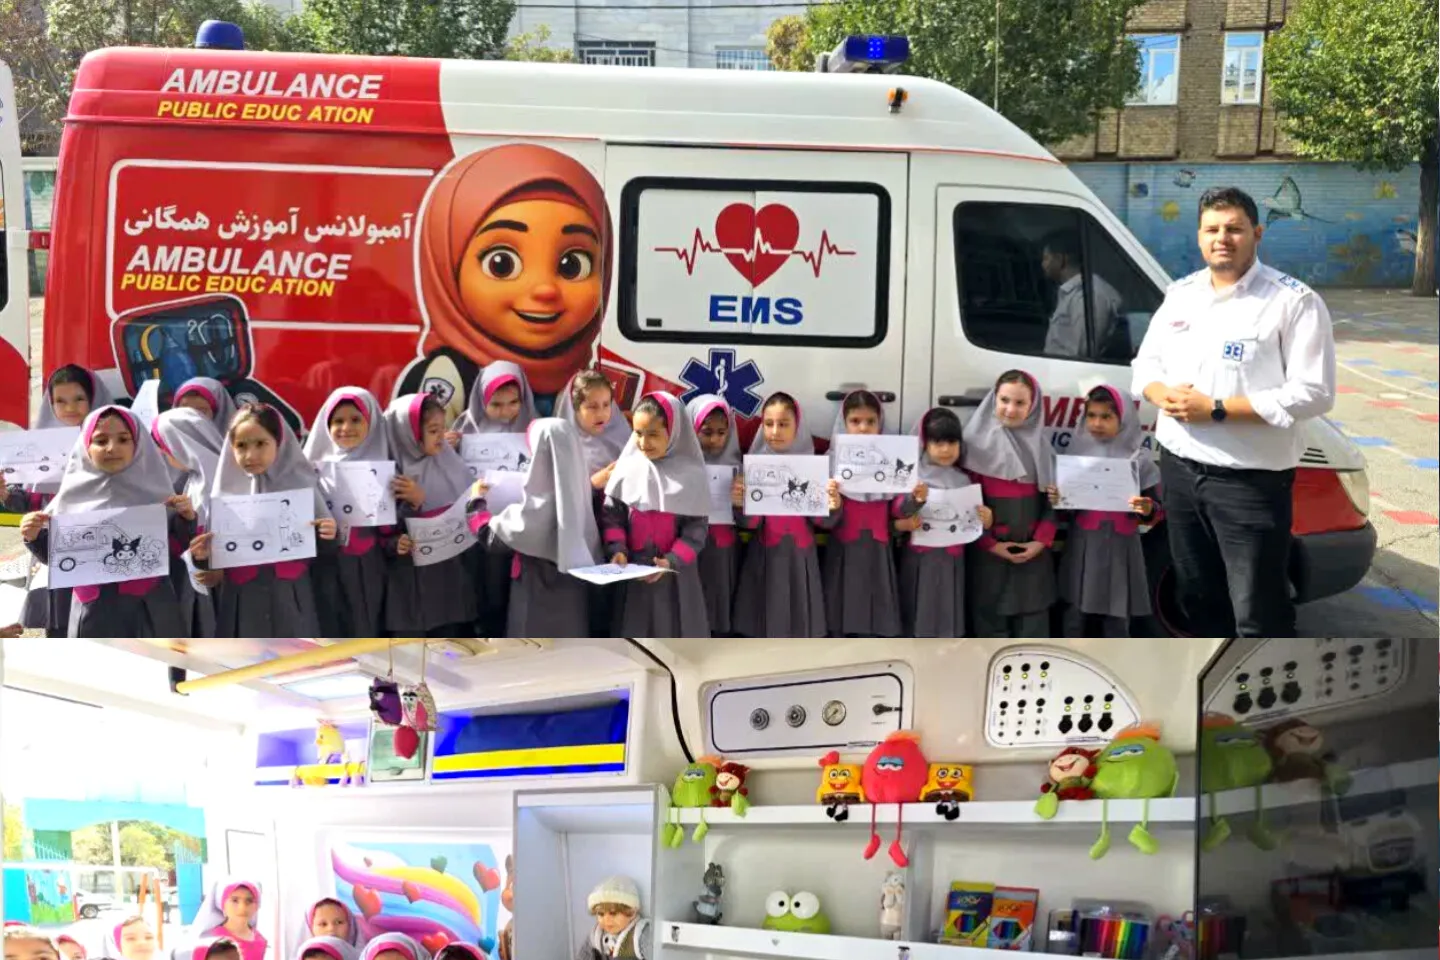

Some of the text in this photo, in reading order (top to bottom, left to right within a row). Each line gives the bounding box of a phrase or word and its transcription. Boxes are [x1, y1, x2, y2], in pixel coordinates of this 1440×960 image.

[161, 68, 383, 99] AMBULANCE
[157, 101, 374, 124] PUBLIC EDUC ATION
[124, 205, 413, 244] آمبولانس آموزش همگانی
[126, 245, 352, 280] AMBULANCE
[120, 273, 201, 293] PUBLIC
[709, 294, 804, 326] EMS
